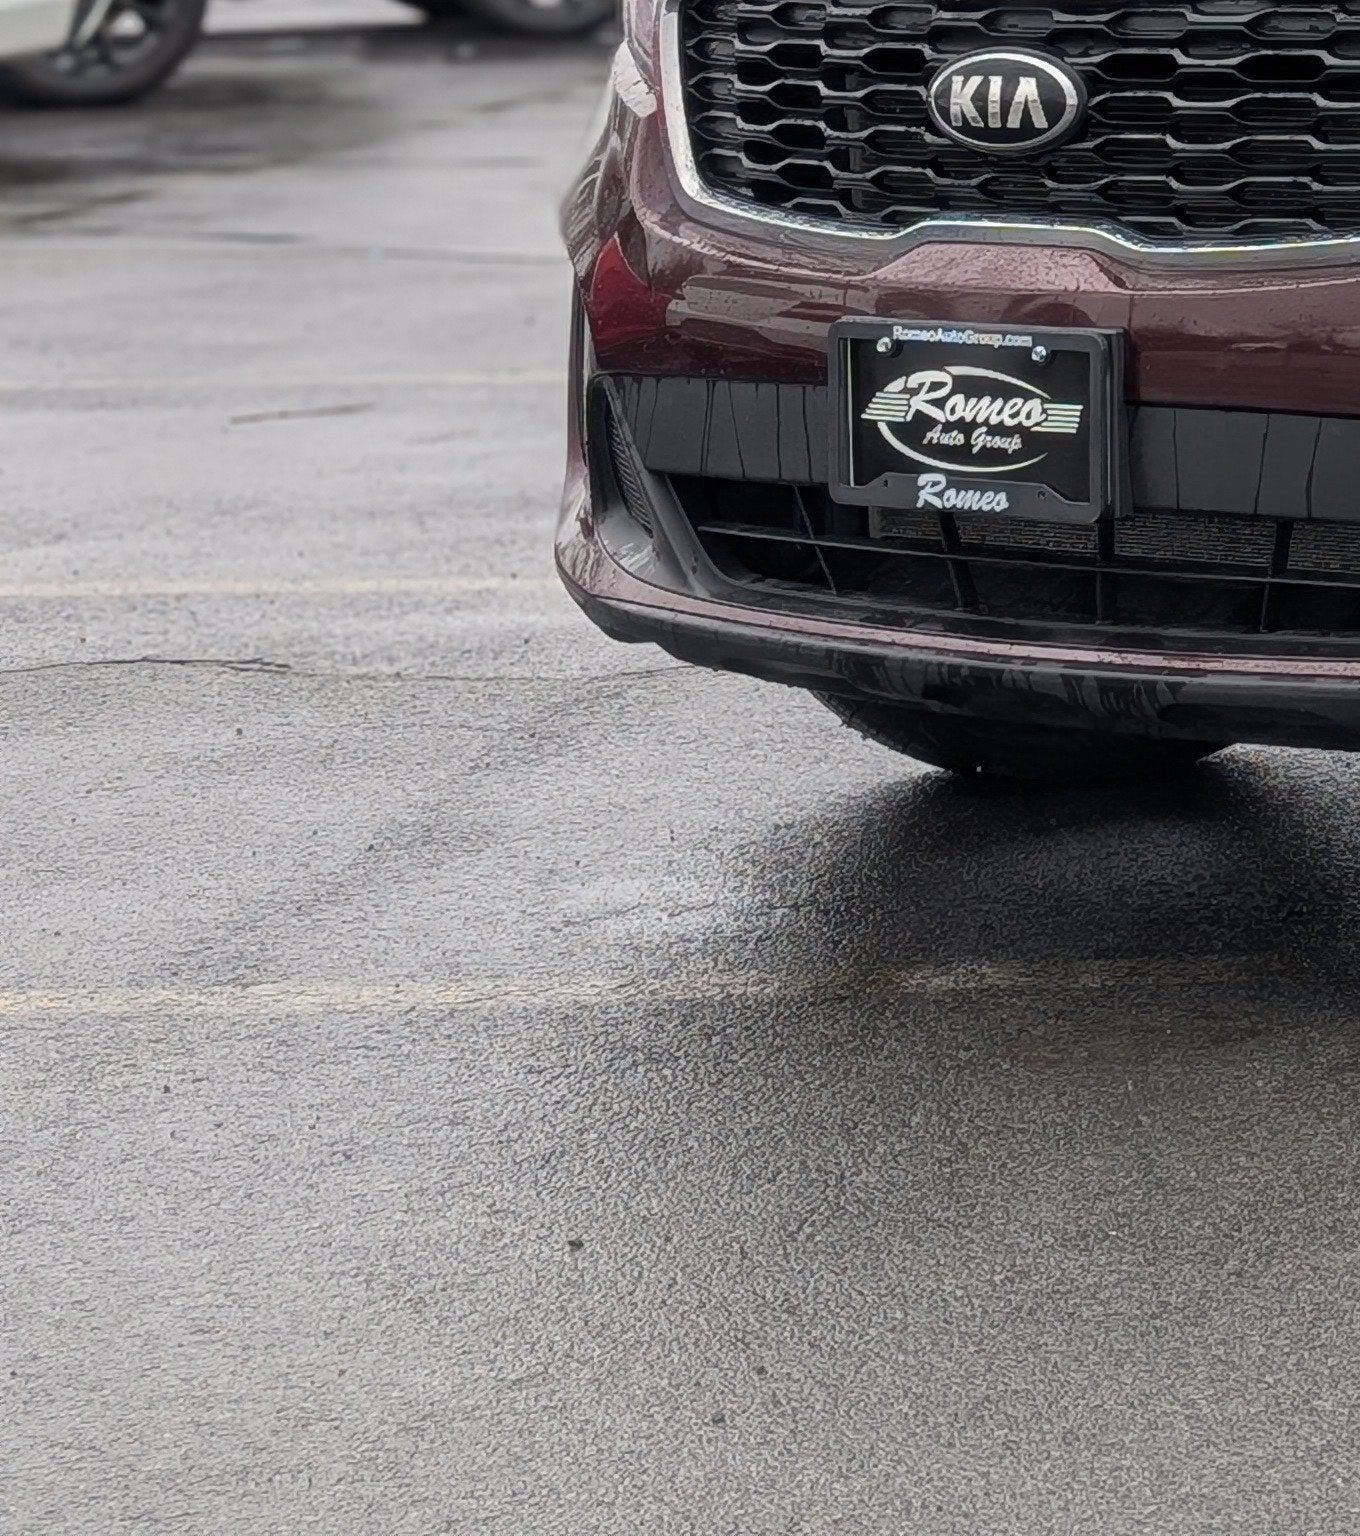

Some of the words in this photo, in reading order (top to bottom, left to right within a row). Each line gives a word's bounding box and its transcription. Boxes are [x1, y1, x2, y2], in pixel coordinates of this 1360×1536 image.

[950, 75, 1049, 129] KIA
[905, 370, 1047, 428] Romeo
[922, 423, 965, 446] Auto
[970, 425, 1022, 455] Group
[915, 472, 1010, 513] Romeo
